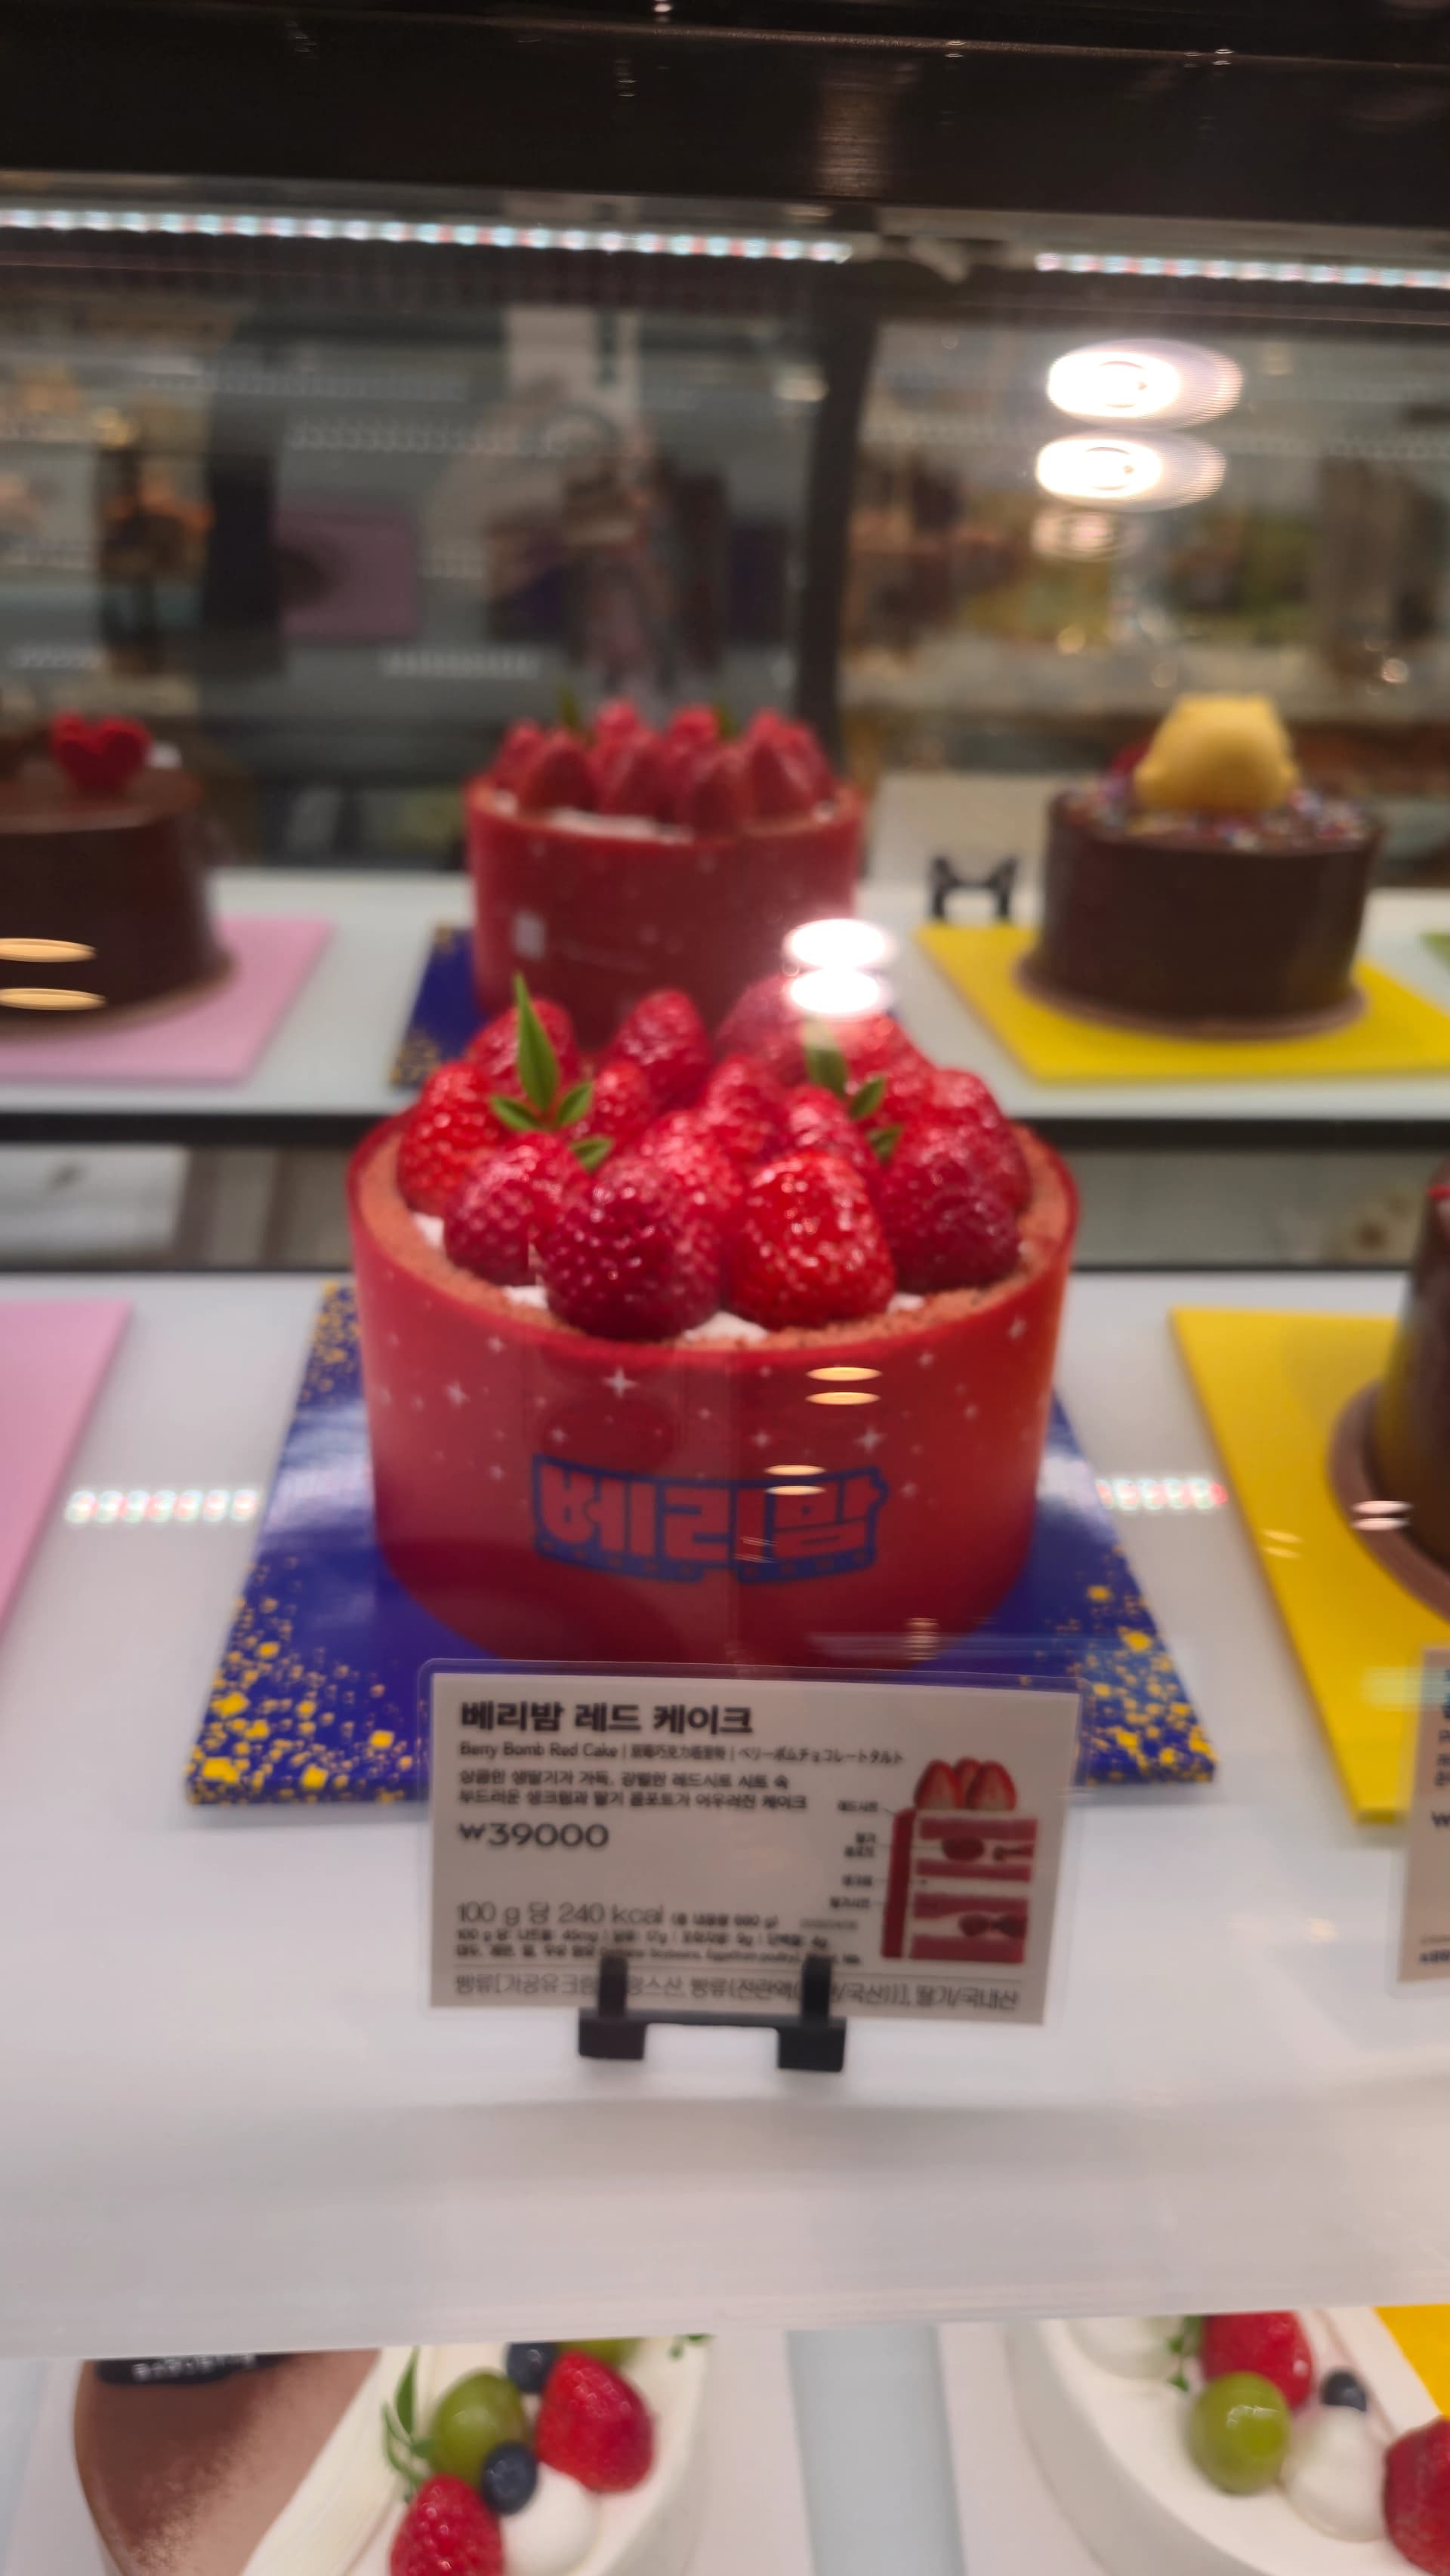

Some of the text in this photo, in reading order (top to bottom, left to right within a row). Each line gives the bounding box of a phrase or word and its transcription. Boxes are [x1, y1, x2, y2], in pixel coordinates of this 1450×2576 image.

[536, 1460, 885, 1563] 베리밤
[461, 1701, 753, 1734] 베리밤 레드 케이크
[459, 1741, 618, 1758] Berry Bomb Red Cake
[739, 1774, 767, 1788] 시트
[459, 1789, 520, 1804] 부드러운
[526, 1790, 588, 1805] 생크림과
[594, 1791, 625, 1806] 딸기
[696, 1792, 755, 1808] 어우러진
[761, 1795, 807, 1809] 케이크
[459, 1823, 609, 1847] ₩39000
[458, 1902, 495, 1922] 100
[504, 1907, 520, 1925] g
[530, 1901, 549, 1924] 당
[559, 1903, 604, 1923] 240
[612, 1904, 663, 1924] kcal
